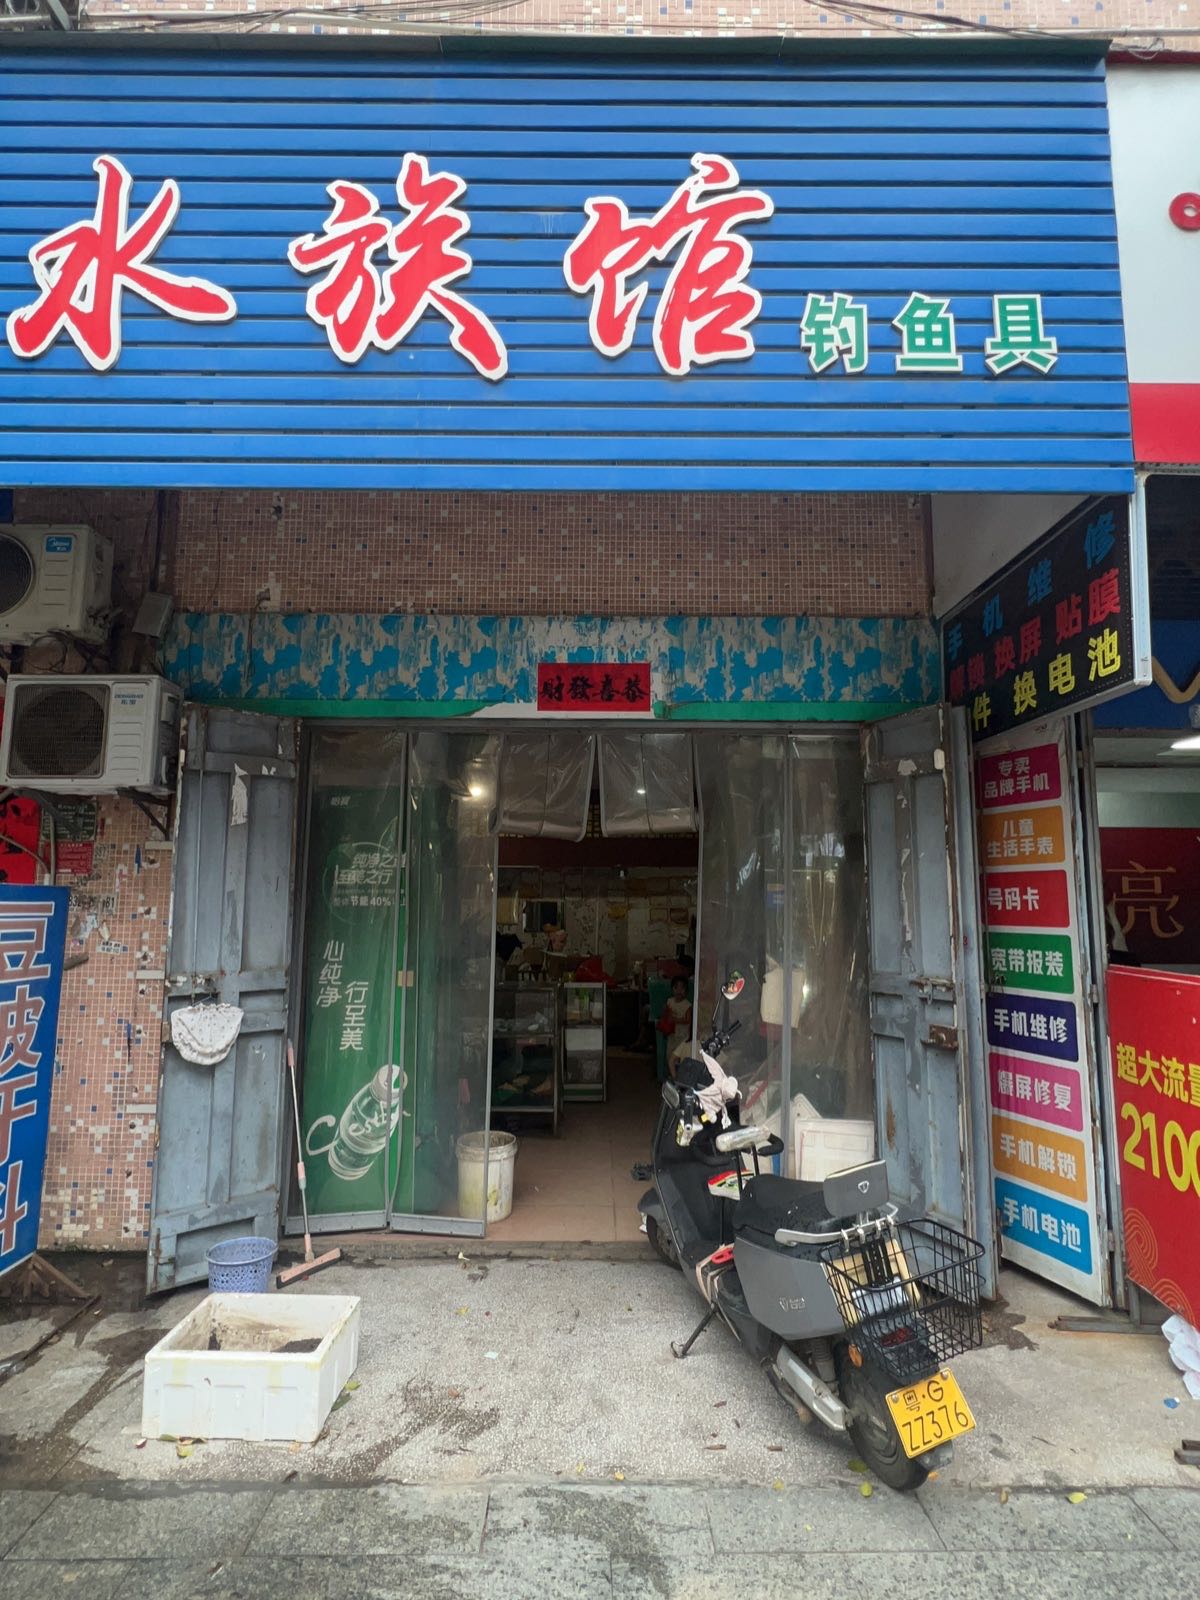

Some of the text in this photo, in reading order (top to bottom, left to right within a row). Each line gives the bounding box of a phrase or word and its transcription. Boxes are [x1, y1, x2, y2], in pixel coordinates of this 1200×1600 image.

[6, 152, 776, 382] 水族馆
[799, 292, 1060, 377] 钓鱼具
[948, 510, 1117, 661] 手机维修
[984, 772, 1050, 799] 品牌手机
[1003, 818, 1034, 838] 儿童
[987, 886, 1040, 912] 号码卡
[1106, 860, 1185, 939] 亮
[316, 939, 345, 1009] 心纯净
[991, 946, 1064, 977] 宽带报装
[339, 980, 369, 1051] 行至美
[993, 1008, 1068, 1043] 手机维修
[998, 1070, 1072, 1113] 爆屏修复
[1000, 1133, 1077, 1182] 手机解锁
[1003, 1197, 1082, 1253] 手机电池
